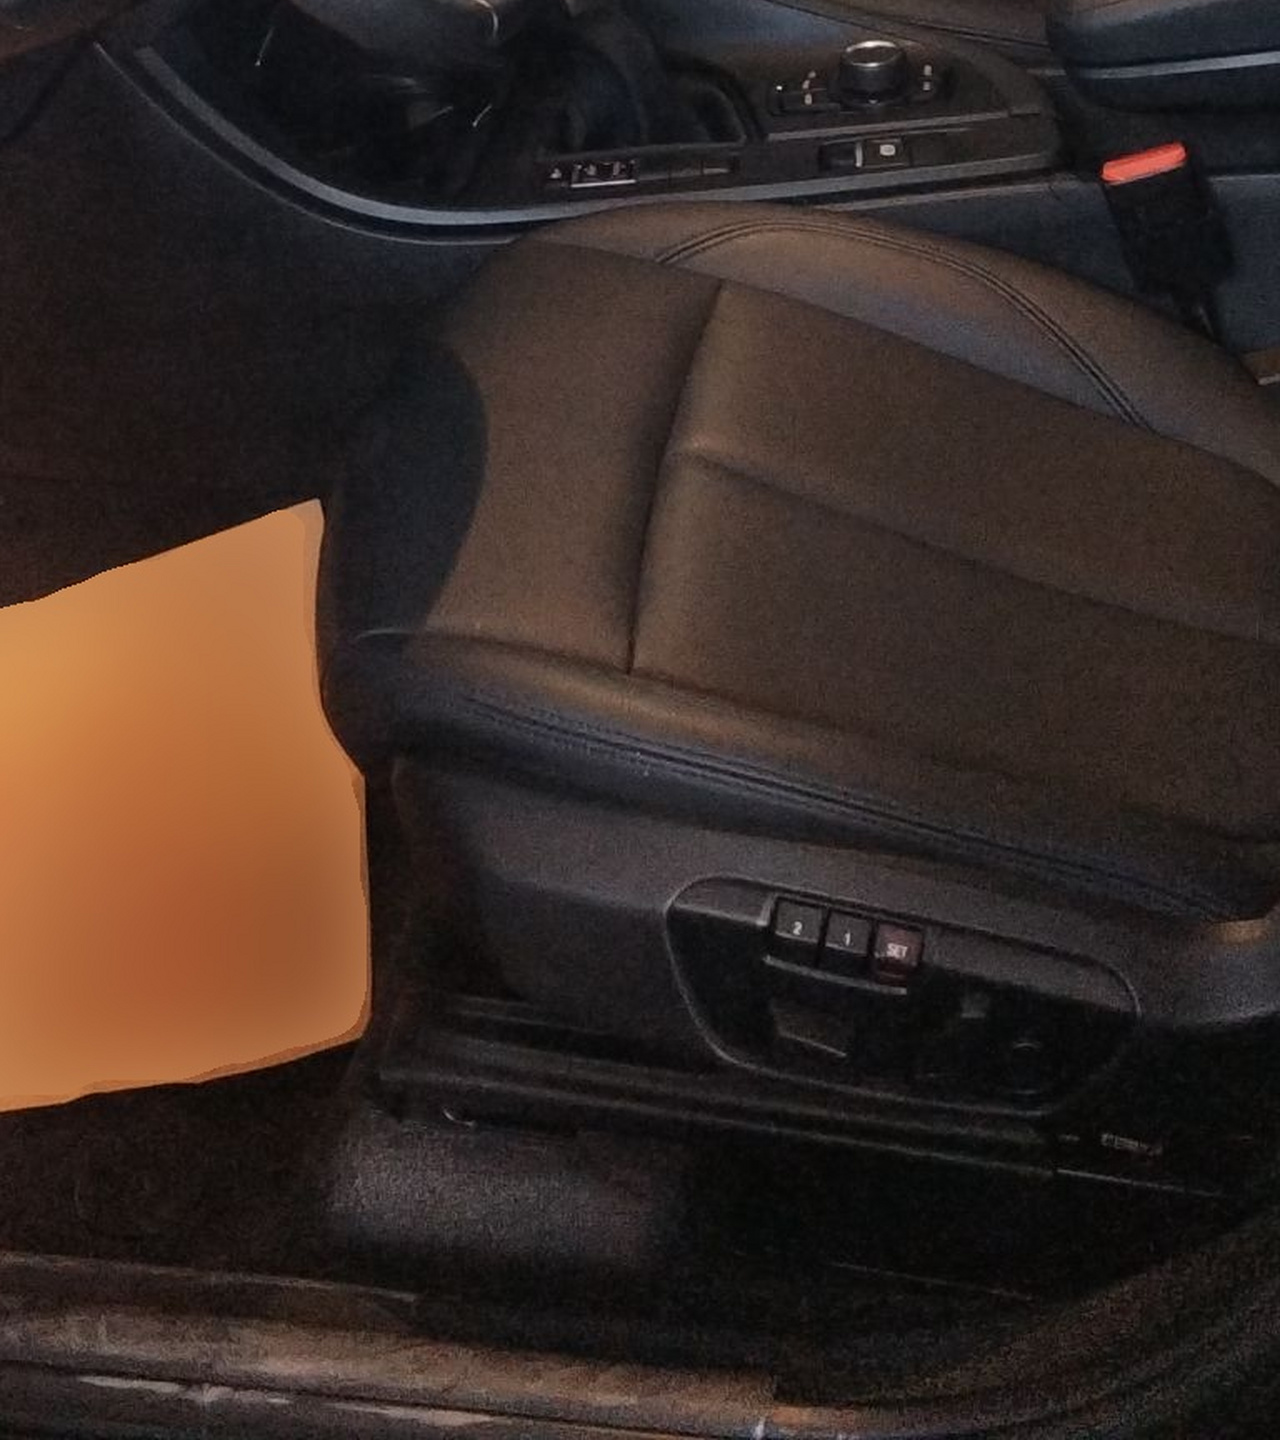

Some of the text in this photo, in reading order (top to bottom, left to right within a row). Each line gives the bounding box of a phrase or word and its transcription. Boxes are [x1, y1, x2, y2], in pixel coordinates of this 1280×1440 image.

[792, 921, 803, 936] 2
[844, 931, 851, 946] 1
[887, 943, 908, 958] SET
